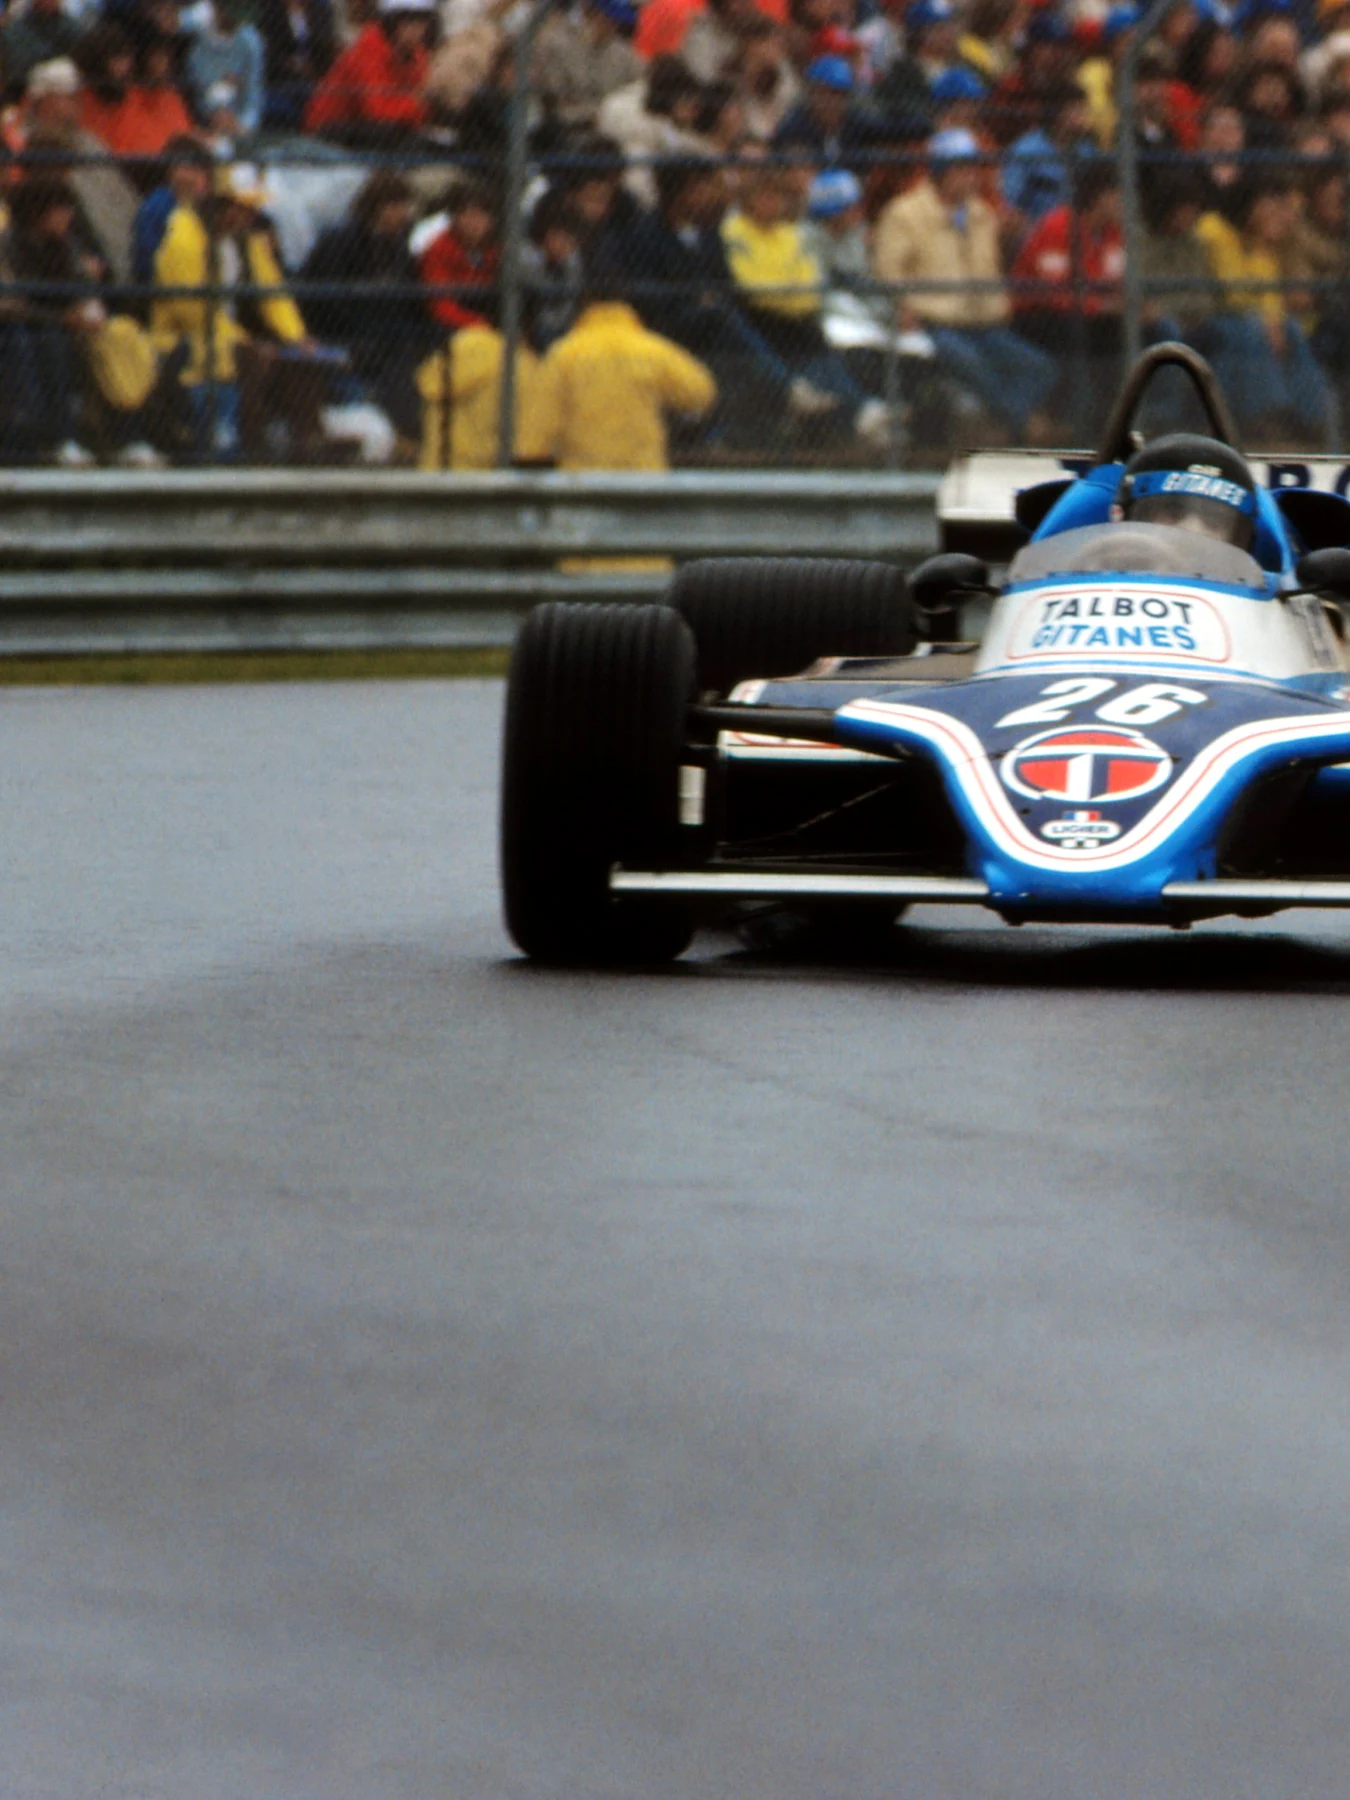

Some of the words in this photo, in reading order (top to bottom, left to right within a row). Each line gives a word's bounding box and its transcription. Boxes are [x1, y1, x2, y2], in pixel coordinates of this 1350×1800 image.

[1161, 472, 1248, 506] GITANES
[1043, 597, 1193, 625] TALBOT
[1031, 624, 1197, 651] GITANES
[993, 677, 1209, 728] 26
